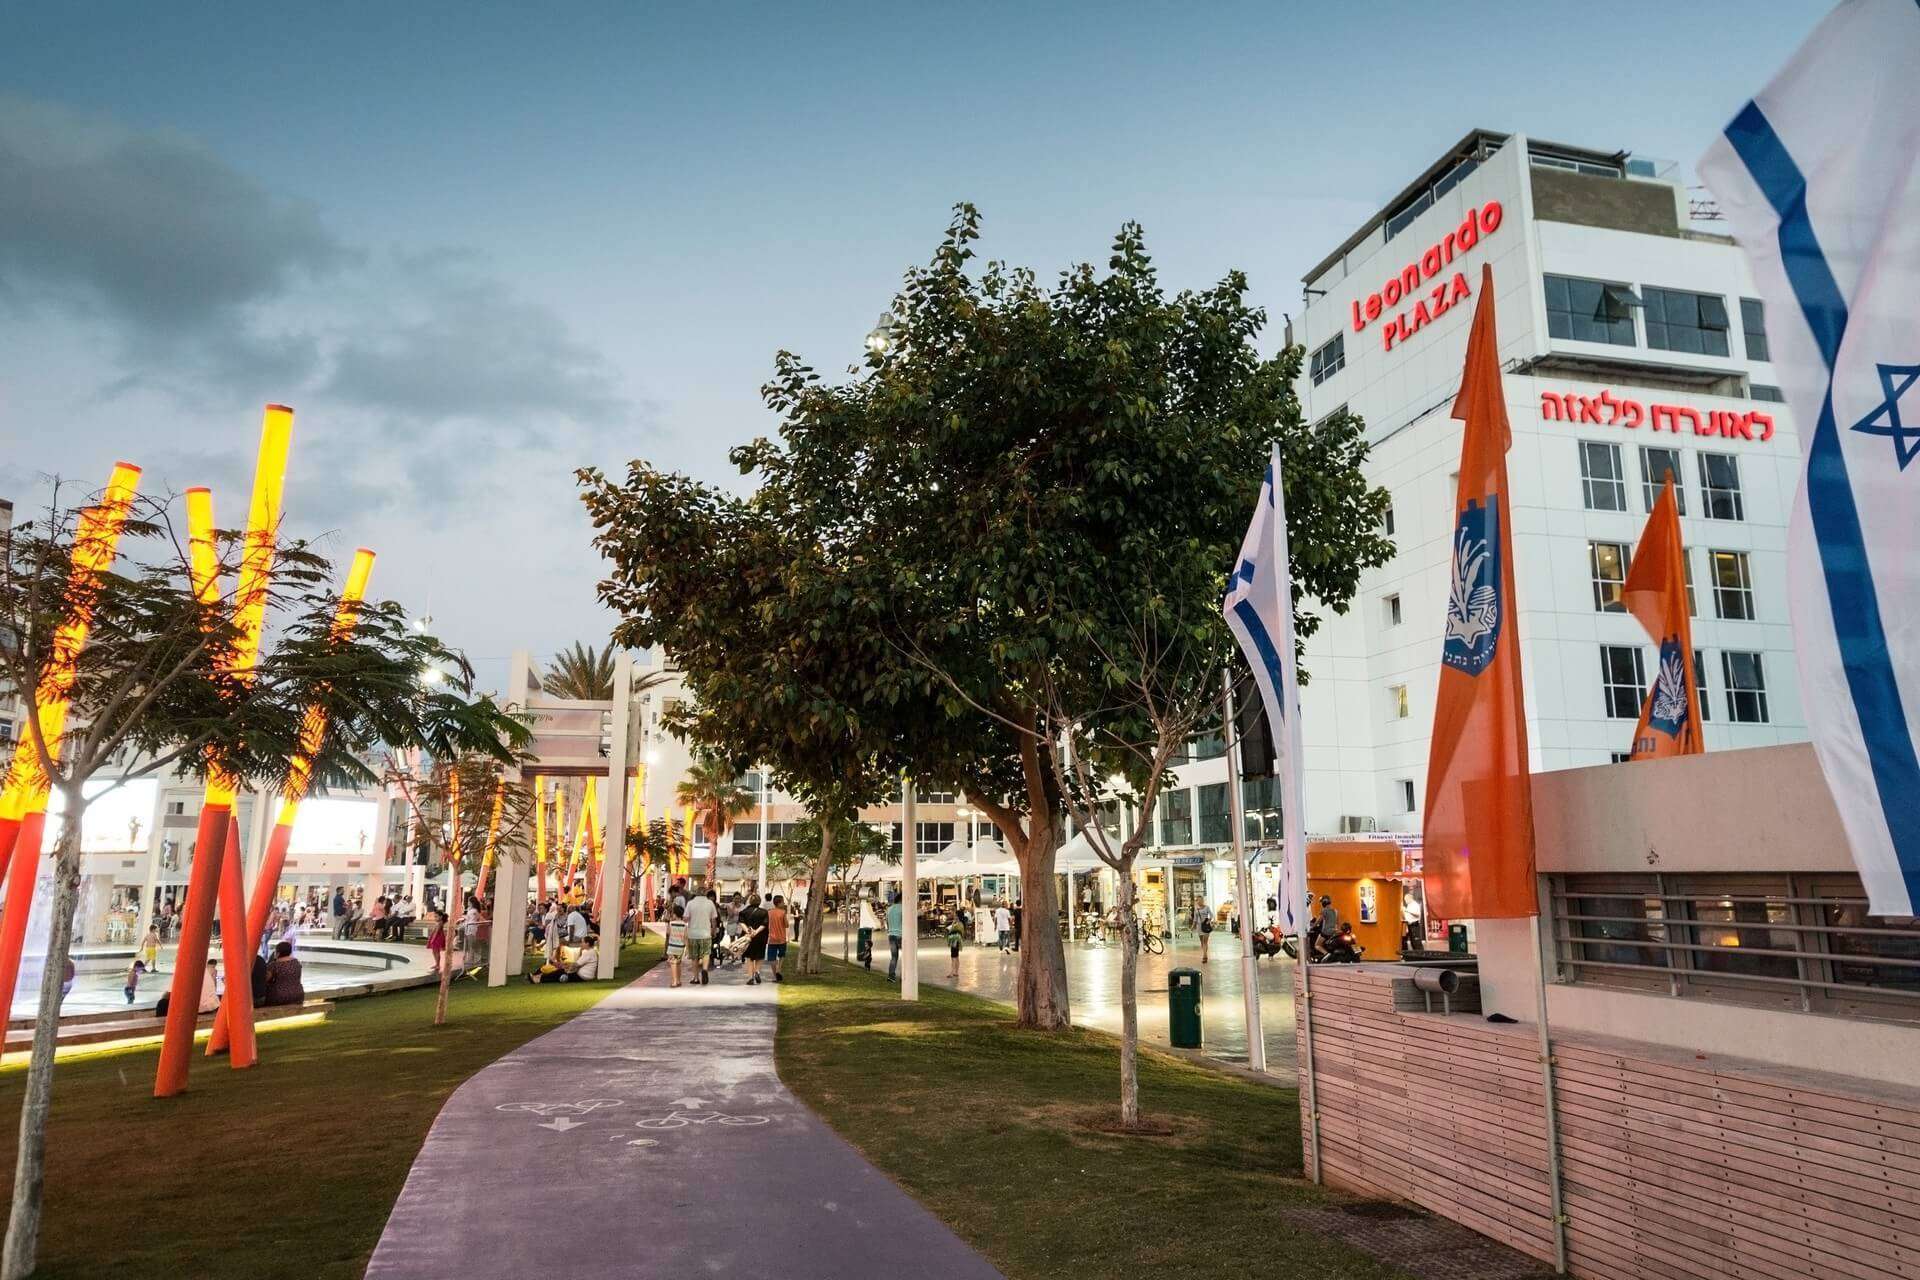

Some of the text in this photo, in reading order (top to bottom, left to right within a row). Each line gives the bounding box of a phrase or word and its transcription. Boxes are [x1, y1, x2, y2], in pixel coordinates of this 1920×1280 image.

[1352, 201, 1502, 332] Leonardo
[1383, 272, 1471, 352] PLAZA
[1541, 389, 1776, 441] לאונרדו פלאזה
